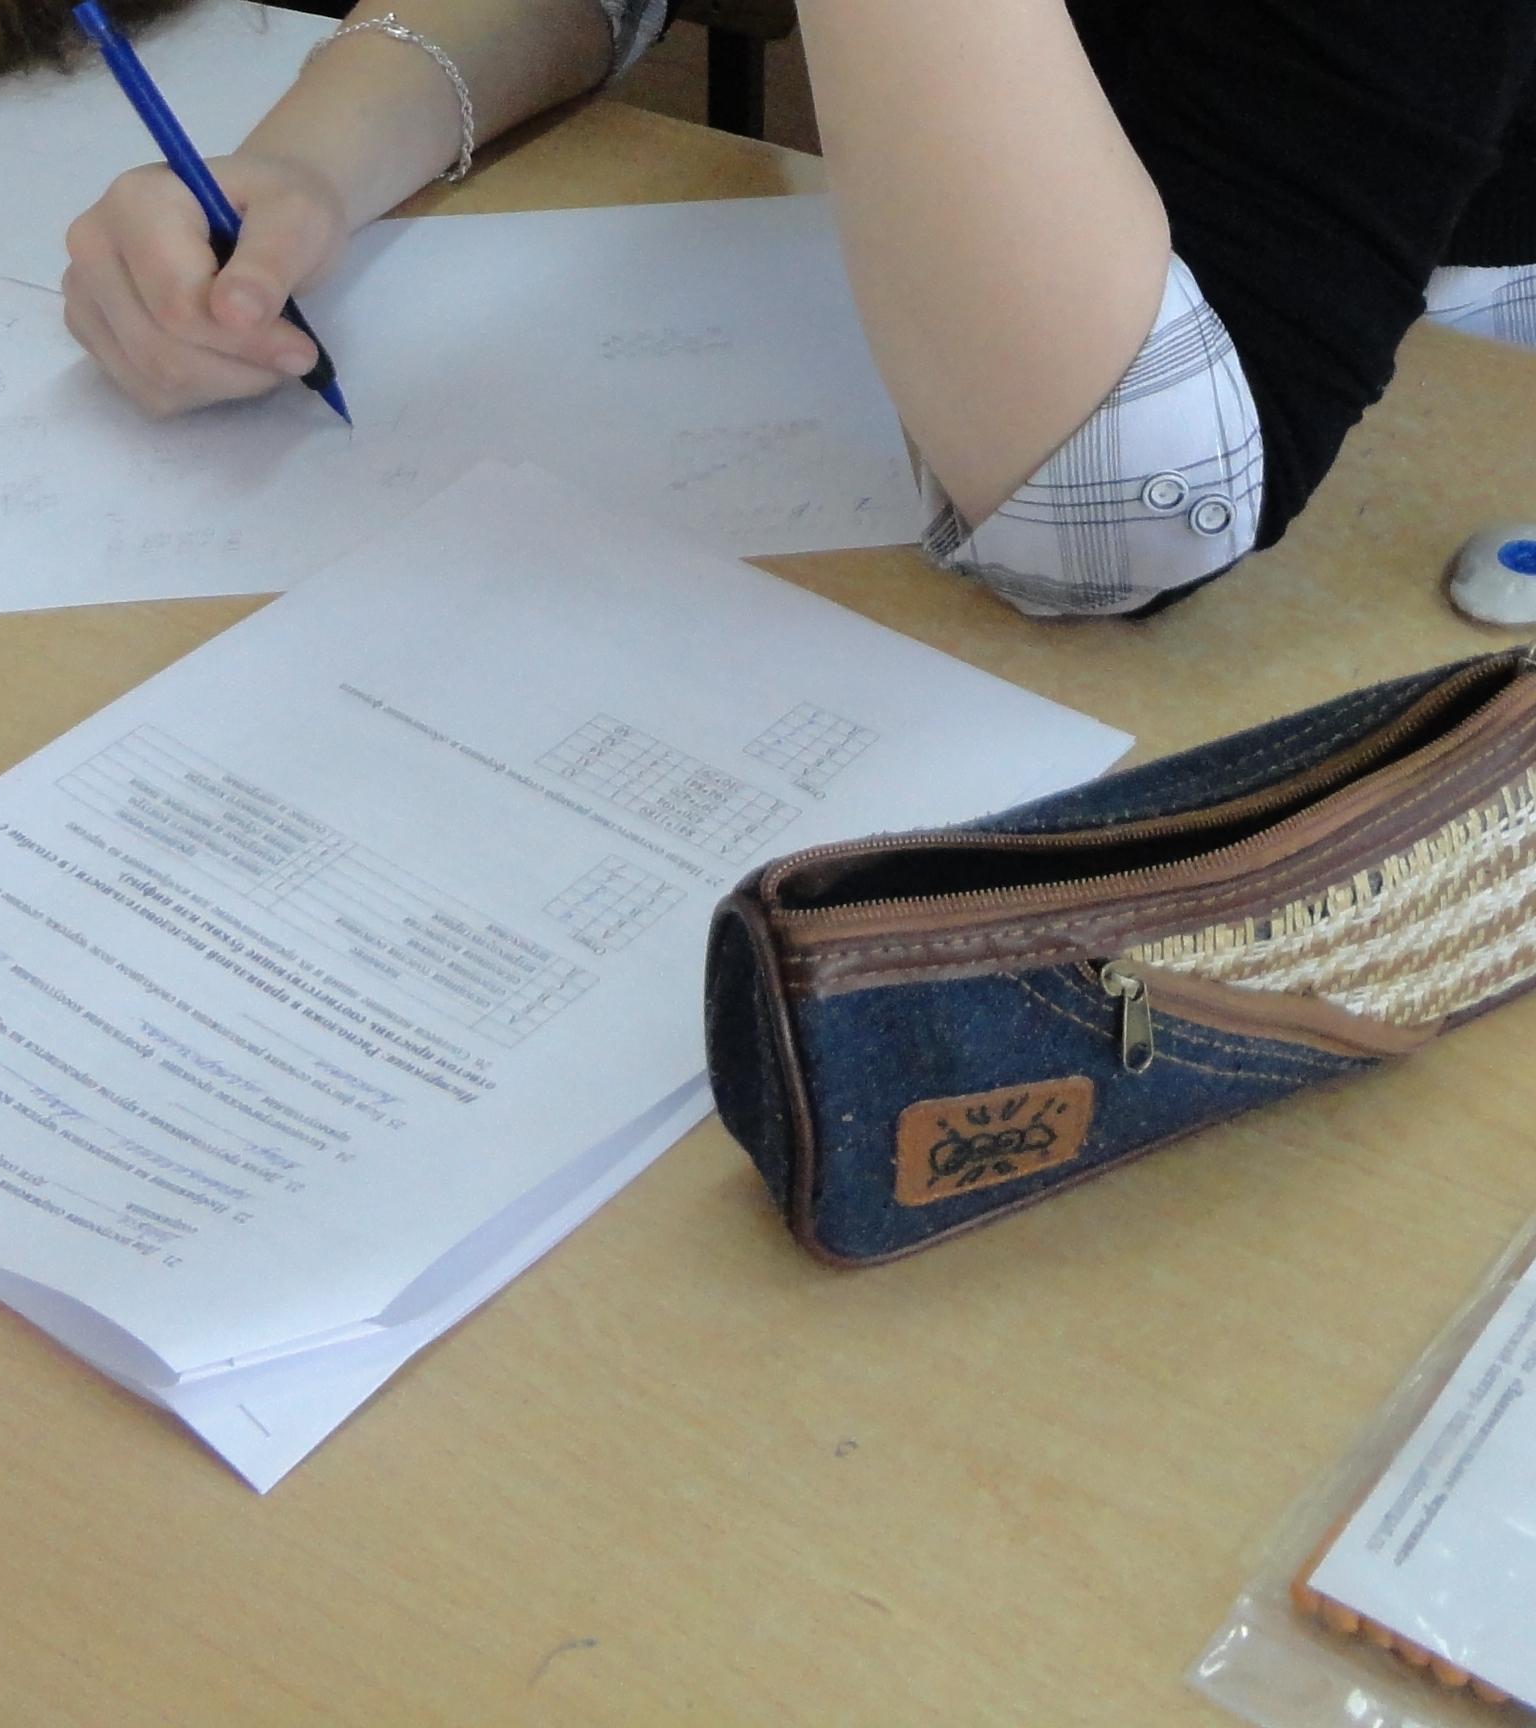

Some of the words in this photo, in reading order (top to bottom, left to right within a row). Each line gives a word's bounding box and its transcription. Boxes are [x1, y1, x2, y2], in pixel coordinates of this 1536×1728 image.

[5, 829, 60, 865] столбце
[113, 869, 177, 908] цифры).
[73, 869, 209, 952] последовательности
[169, 903, 201, 923] или
[197, 920, 248, 954] буквы
[333, 916, 391, 951] основная
[403, 938, 448, 965] тонкая
[201, 948, 294, 1003] правильной
[385, 946, 434, 976] толстая
[242, 948, 369, 1024] соответствующие
[318, 974, 362, 999] линий
[299, 1007, 382, 1058] Расположи
[365, 1020, 439, 1061] проставь
[433, 1056, 499, 1092] ответом
[94, 1085, 143, 1112] кругом
